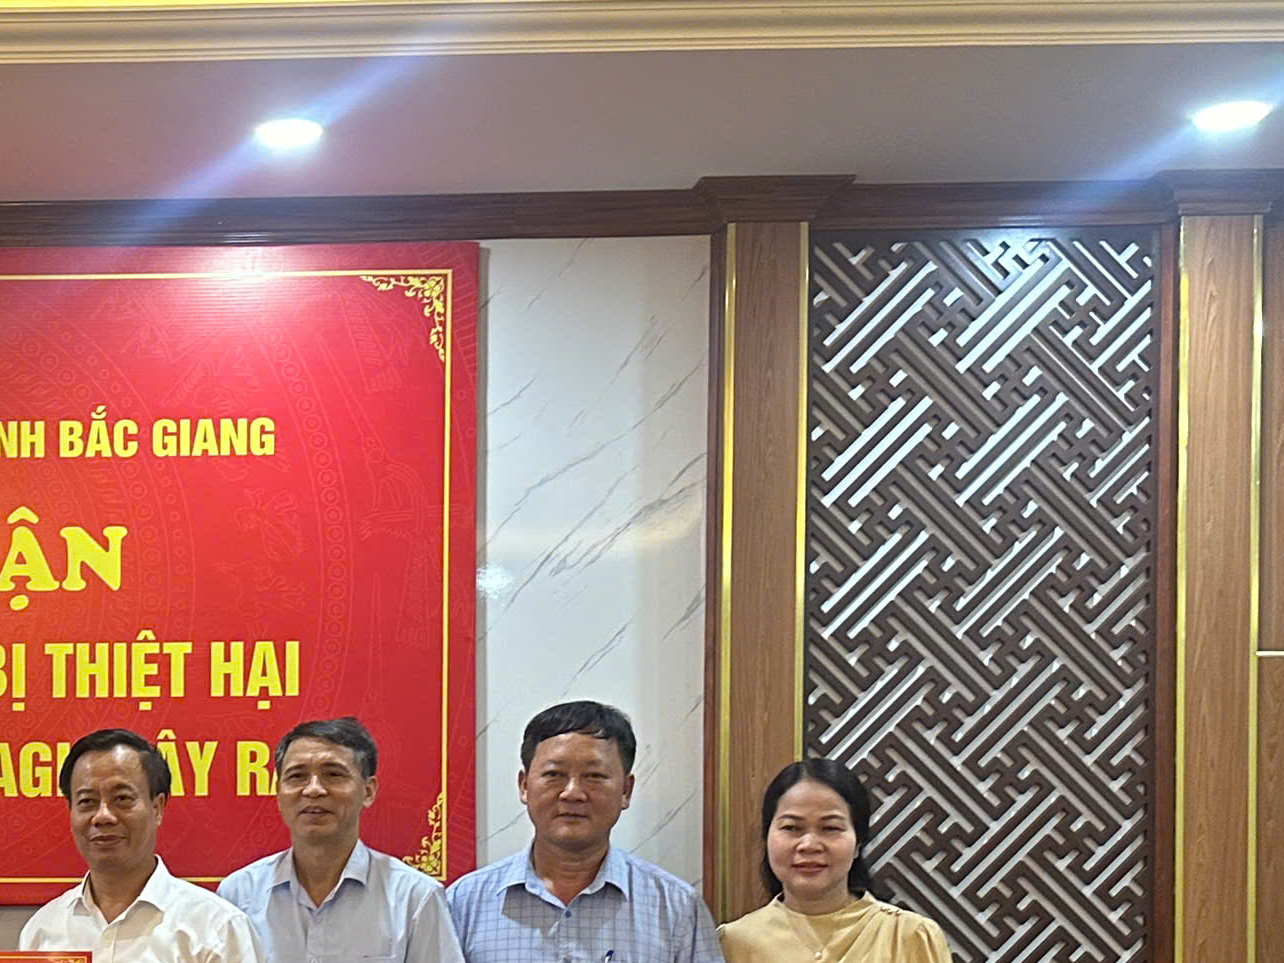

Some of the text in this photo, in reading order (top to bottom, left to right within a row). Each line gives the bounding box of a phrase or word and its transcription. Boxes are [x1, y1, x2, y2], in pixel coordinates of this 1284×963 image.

[59, 405, 139, 458] BẮC
[152, 418, 275, 458] GIANG
[44, 630, 193, 711] THIỆT
[210, 640, 300, 710] HẠI
[154, 729, 218, 797] ÂY
[236, 741, 277, 796] R
